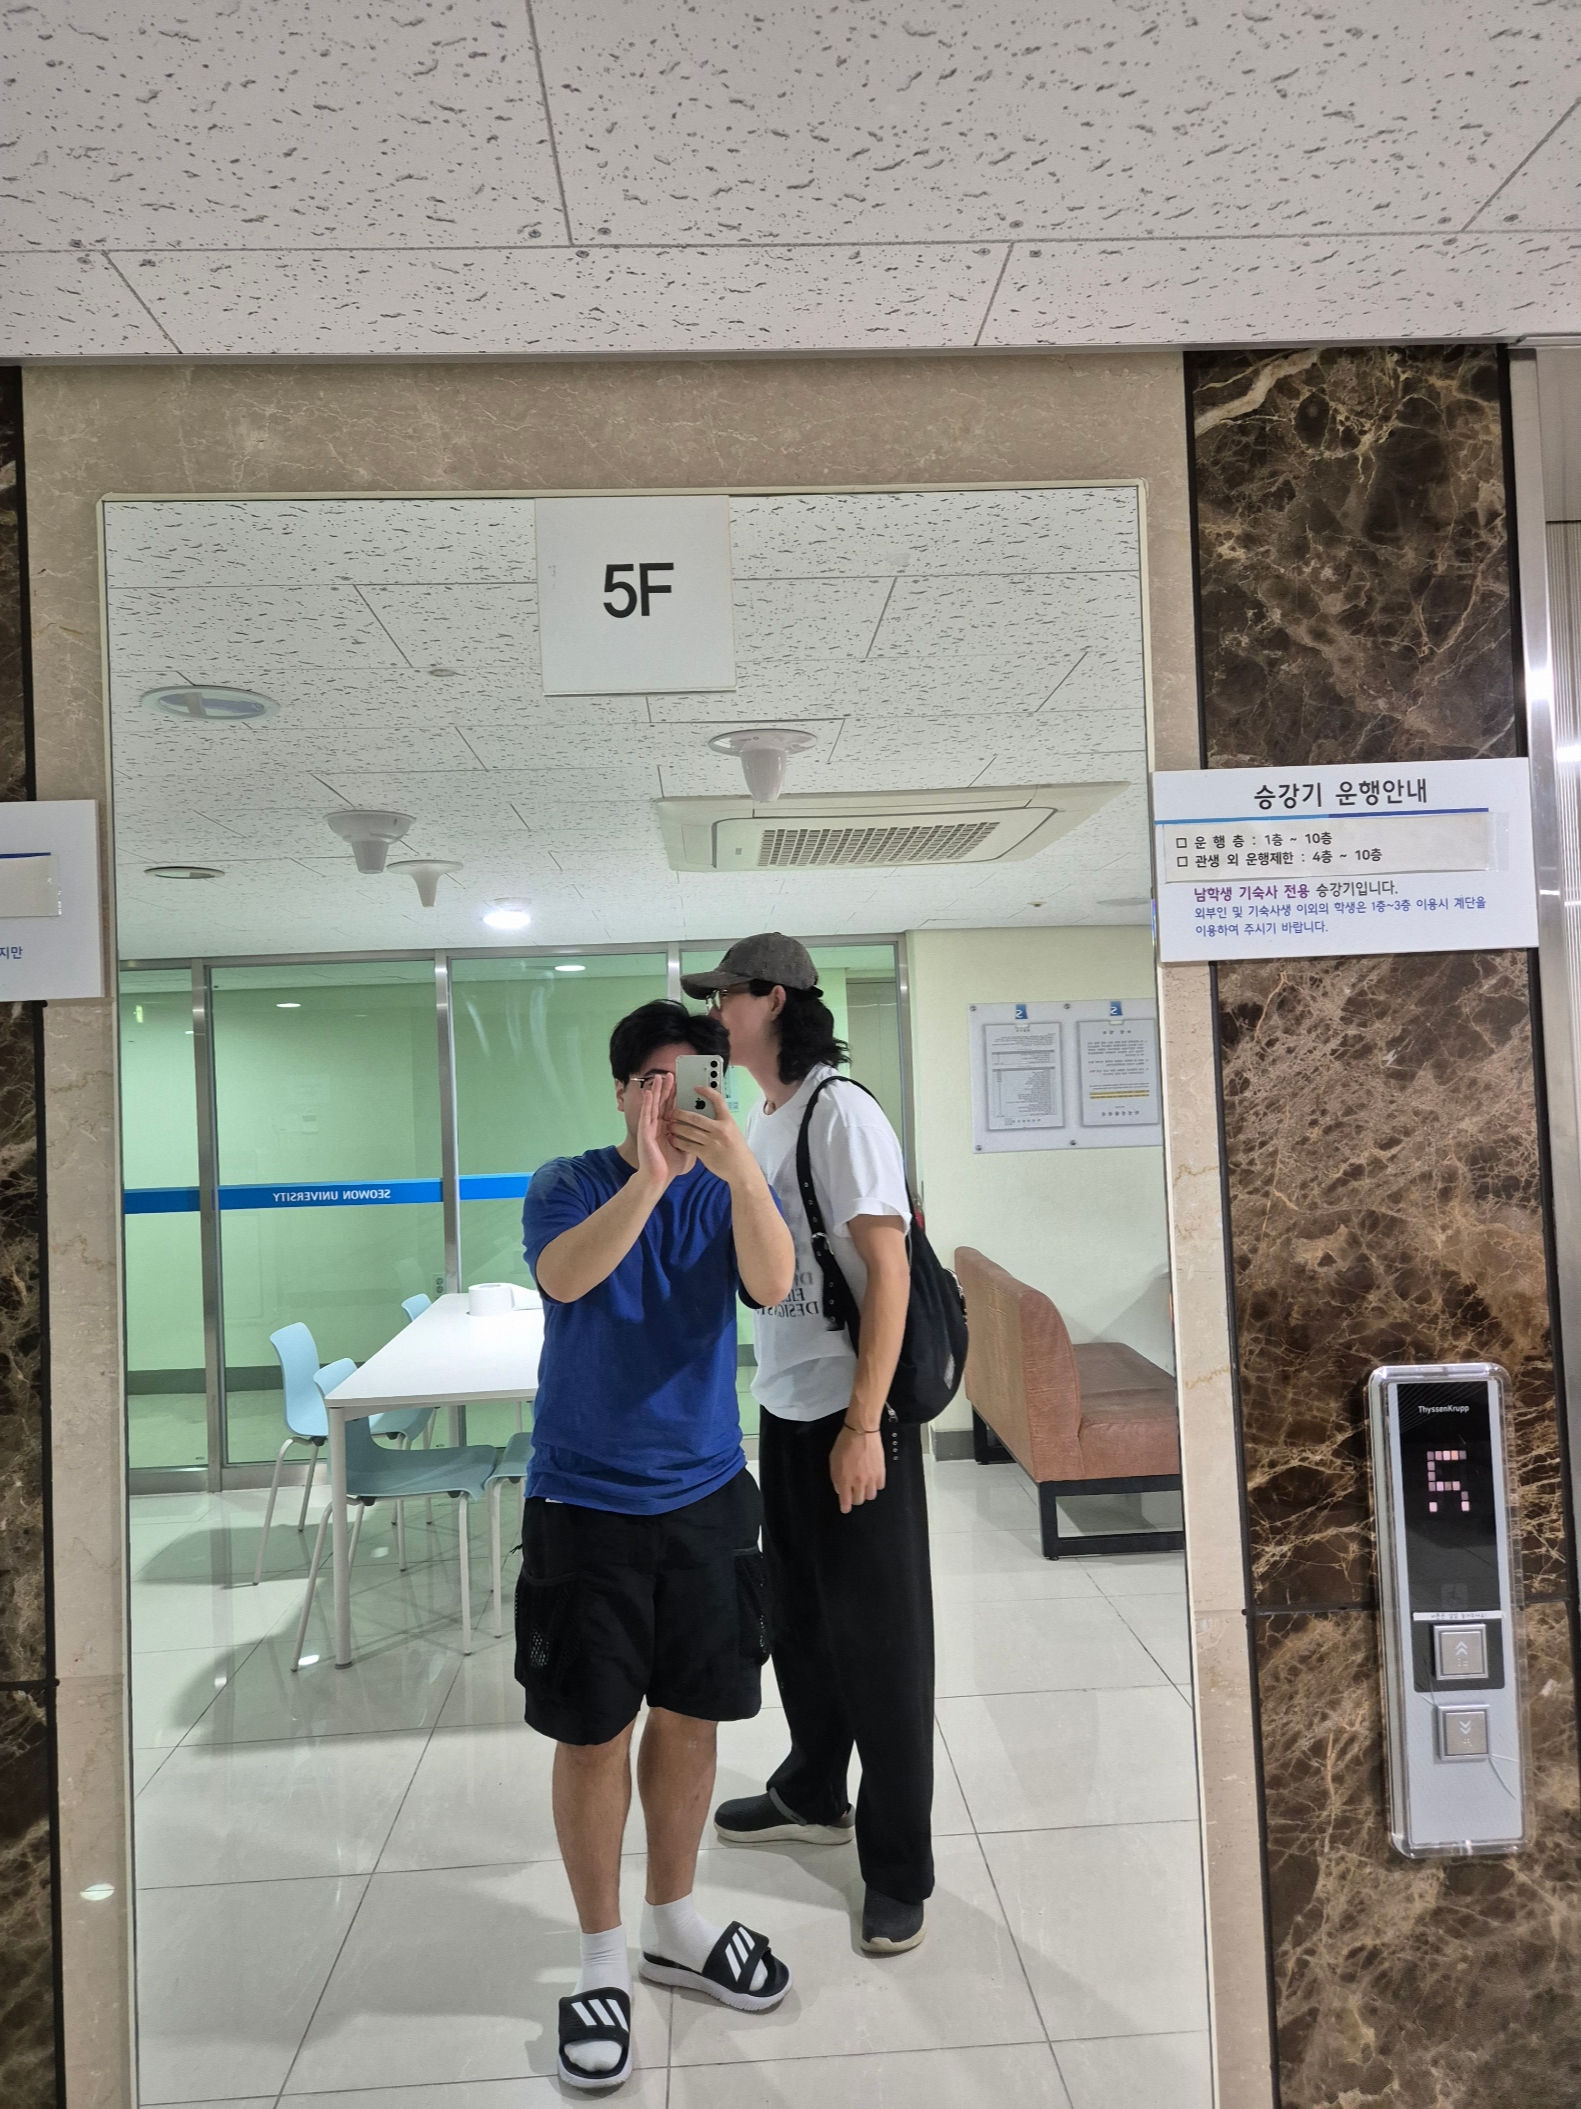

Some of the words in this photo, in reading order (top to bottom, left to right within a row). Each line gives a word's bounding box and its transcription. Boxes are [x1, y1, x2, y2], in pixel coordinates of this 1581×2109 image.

[603, 562, 674, 619] 5F
[1254, 782, 1322, 810] 승강기
[1335, 778, 1427, 806] 운행안내
[1194, 836, 1207, 850] 운
[1212, 835, 1226, 849] 행
[1232, 834, 1245, 848] 층
[1264, 833, 1283, 847] 1층
[1305, 831, 1333, 845] 10층
[1195, 854, 1220, 868] 관생
[1227, 853, 1239, 866] 외
[1245, 851, 1294, 866] 운행제한
[1312, 850, 1333, 864] 4층
[1354, 848, 1382, 861] 10층
[1194, 886, 1232, 902] 남학생
[1239, 885, 1278, 900] 기숙사
[1284, 884, 1310, 899] 전용
[1316, 880, 1398, 898] 승강기입니다.
[1195, 907, 1227, 920] 외부인
[1232, 906, 1243, 918] 및
[1248, 904, 1291, 917] 기숙사생
[1296, 902, 1329, 916] 이외의
[1334, 901, 1367, 914] 학생은
[1371, 898, 1411, 913] 1층~3층
[1416, 898, 1449, 911] 이용시
[1454, 896, 1487, 910] 계단을
[1195, 924, 1239, 938] 이용하여
[1244, 922, 1276, 935] 주시기
[1281, 920, 1328, 934] 바랍니다.
[1417, 1404, 1470, 1414] ThyssenKrupp
